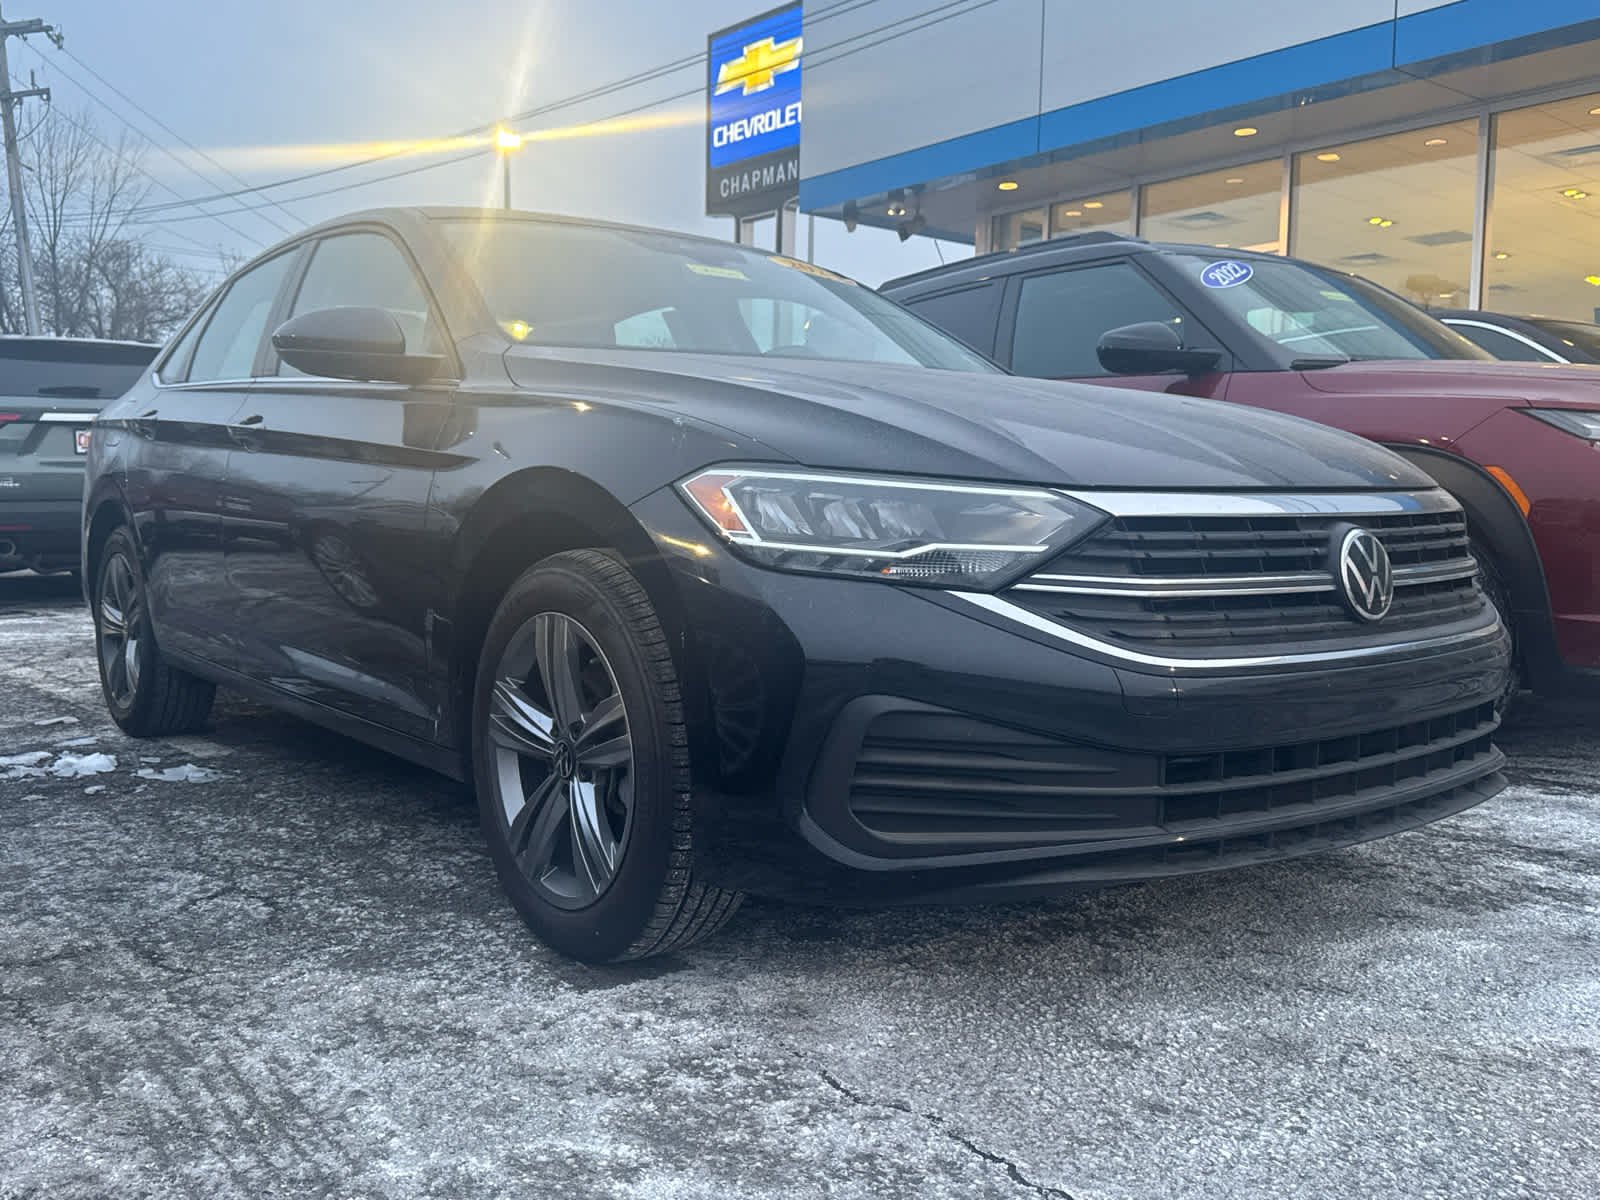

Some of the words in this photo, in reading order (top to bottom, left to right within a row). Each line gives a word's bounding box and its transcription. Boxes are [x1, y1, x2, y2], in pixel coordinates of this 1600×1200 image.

[720, 159, 798, 198] CHAPMAN
[1208, 262, 1248, 286] 2022
[1342, 531, 1392, 616] VW
